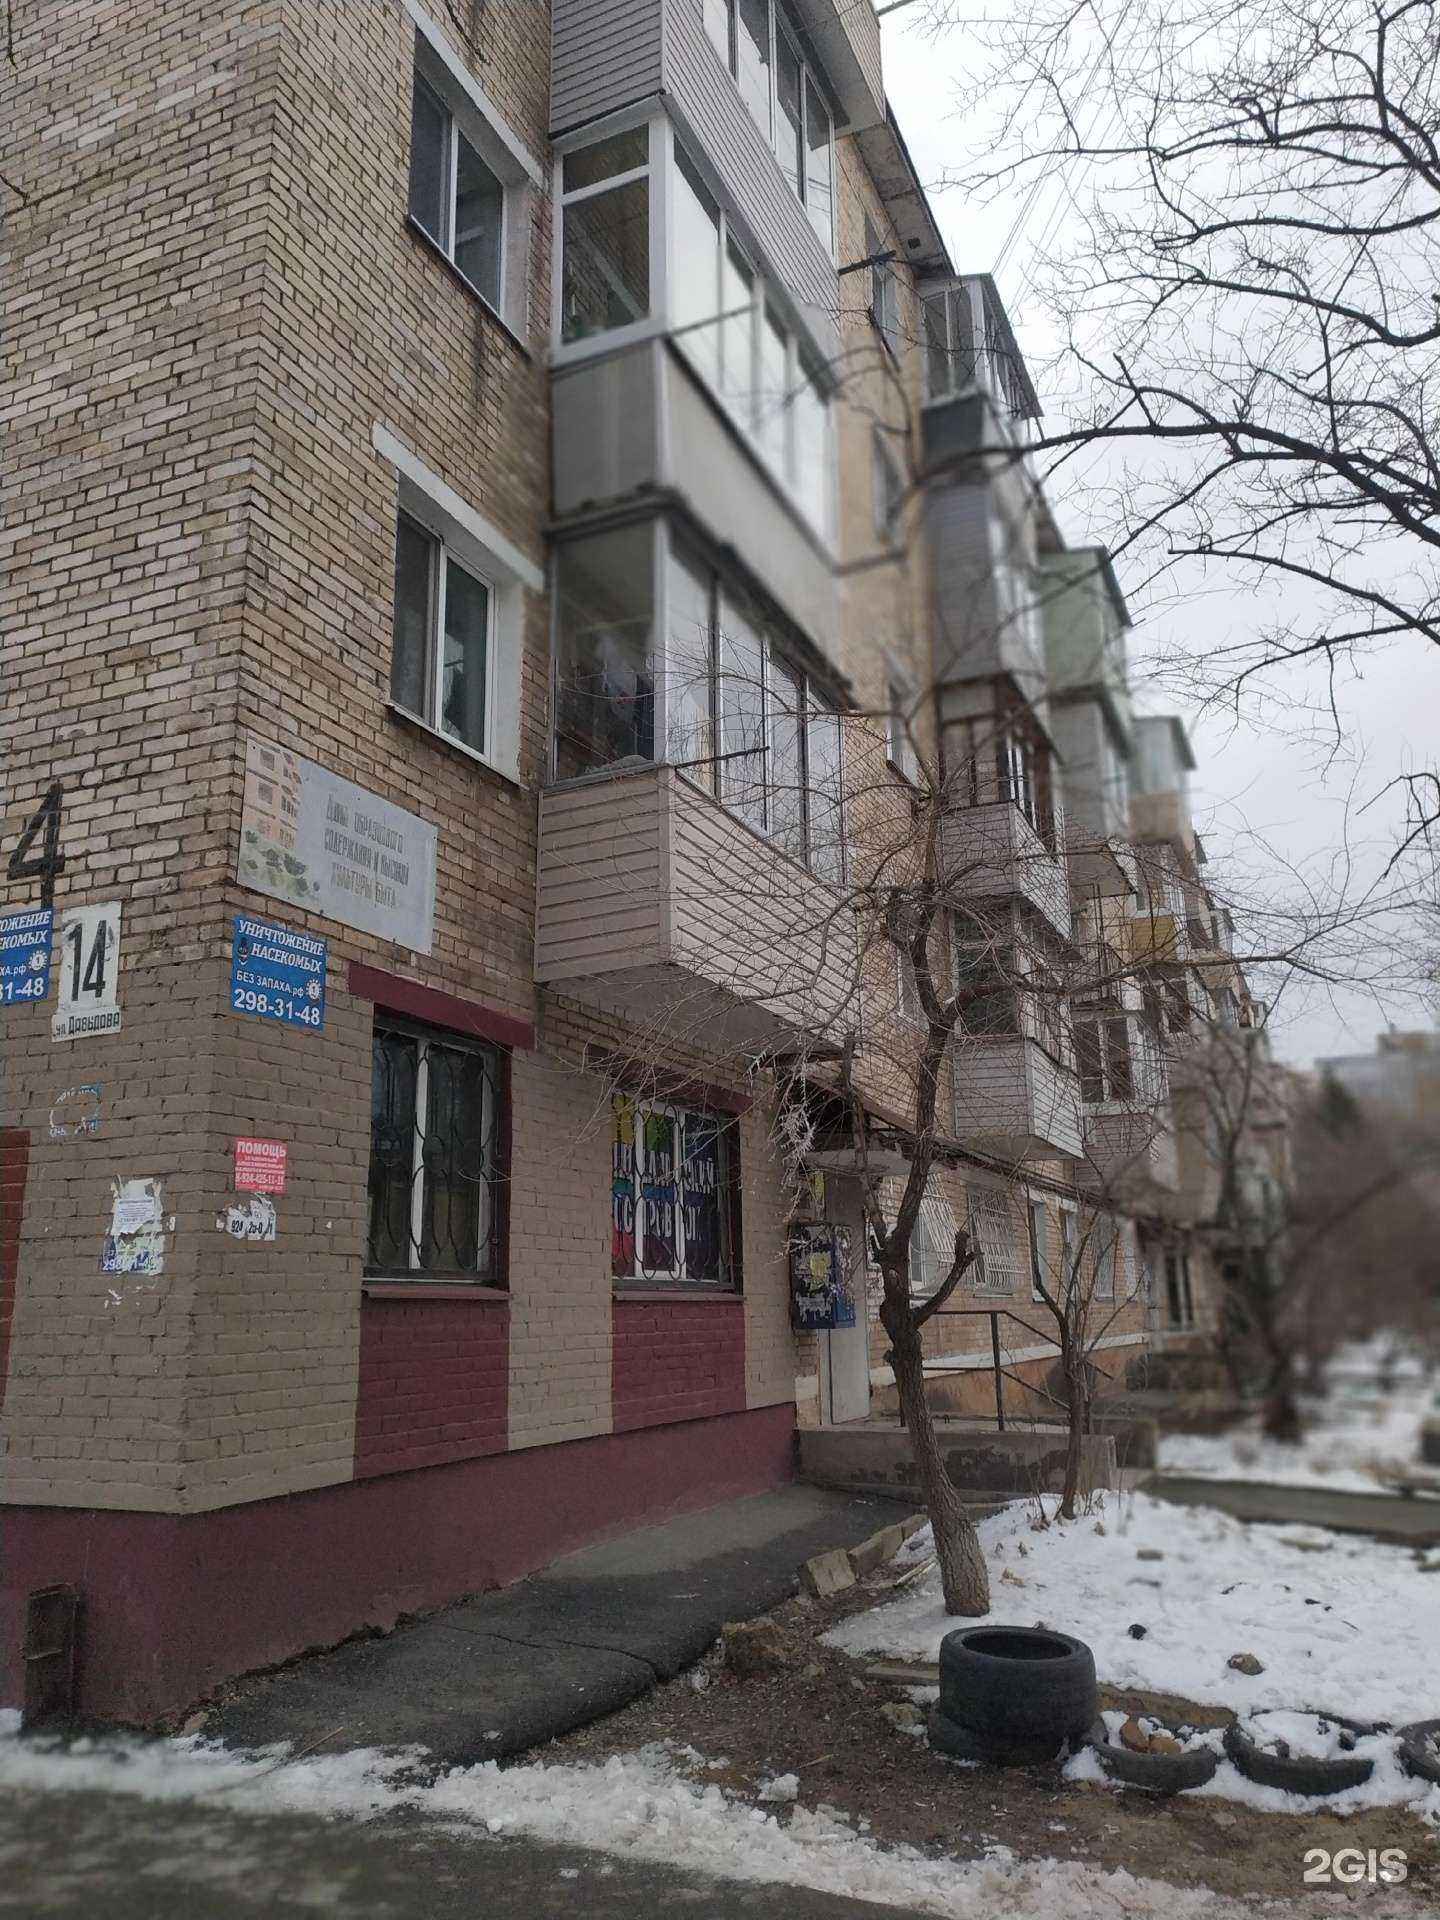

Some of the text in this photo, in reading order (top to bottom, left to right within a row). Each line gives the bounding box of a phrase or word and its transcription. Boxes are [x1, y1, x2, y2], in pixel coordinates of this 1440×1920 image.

[7, 783, 65, 908] 4
[238, 919, 325, 956] УНИЧТОЖЕНИЕ
[68, 920, 107, 1001] 14
[251, 943, 322, 973] НАСЕКОМЫХ
[236, 970, 255, 984] БЕЗ
[234, 988, 320, 1026] 298-31-48
[237, 1141, 286, 1159] ПОМОЩЬ
